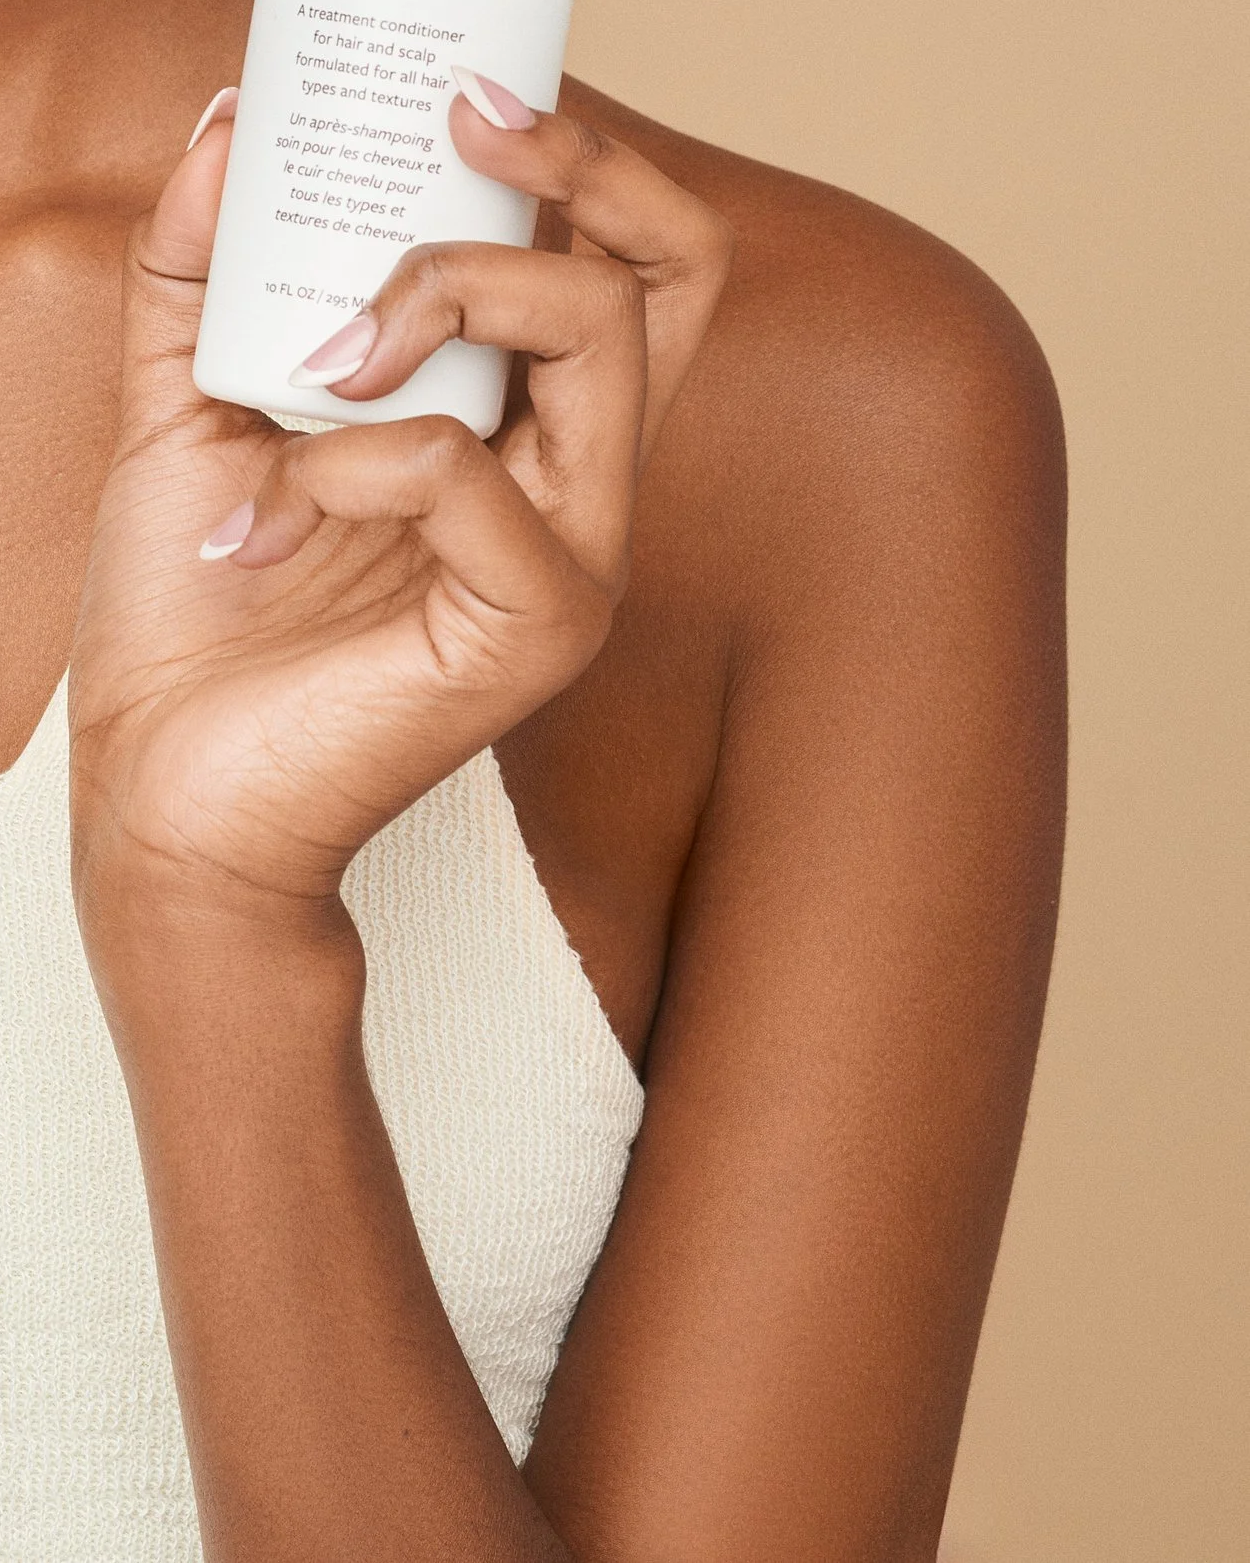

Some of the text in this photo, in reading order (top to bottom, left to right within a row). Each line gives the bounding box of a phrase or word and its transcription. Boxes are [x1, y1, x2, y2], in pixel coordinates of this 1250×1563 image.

[297, 4, 465, 43] A treatment conditioner
[313, 30, 436, 64] for hair and scalp
[296, 52, 450, 90] formulated for all hair
[302, 79, 432, 112] types and textures
[290, 112, 434, 152] Un après-shampoing
[276, 136, 442, 175] soin pour les cheveux et
[284, 160, 423, 196] le cuir chevelu pour
[290, 187, 406, 219] tous les types et
[275, 209, 415, 244] textures de cheveux
[265, 282, 277, 293] 10
[280, 283, 294, 297] FL
[297, 286, 315, 301] OZ
[326, 293, 348, 308] 295
